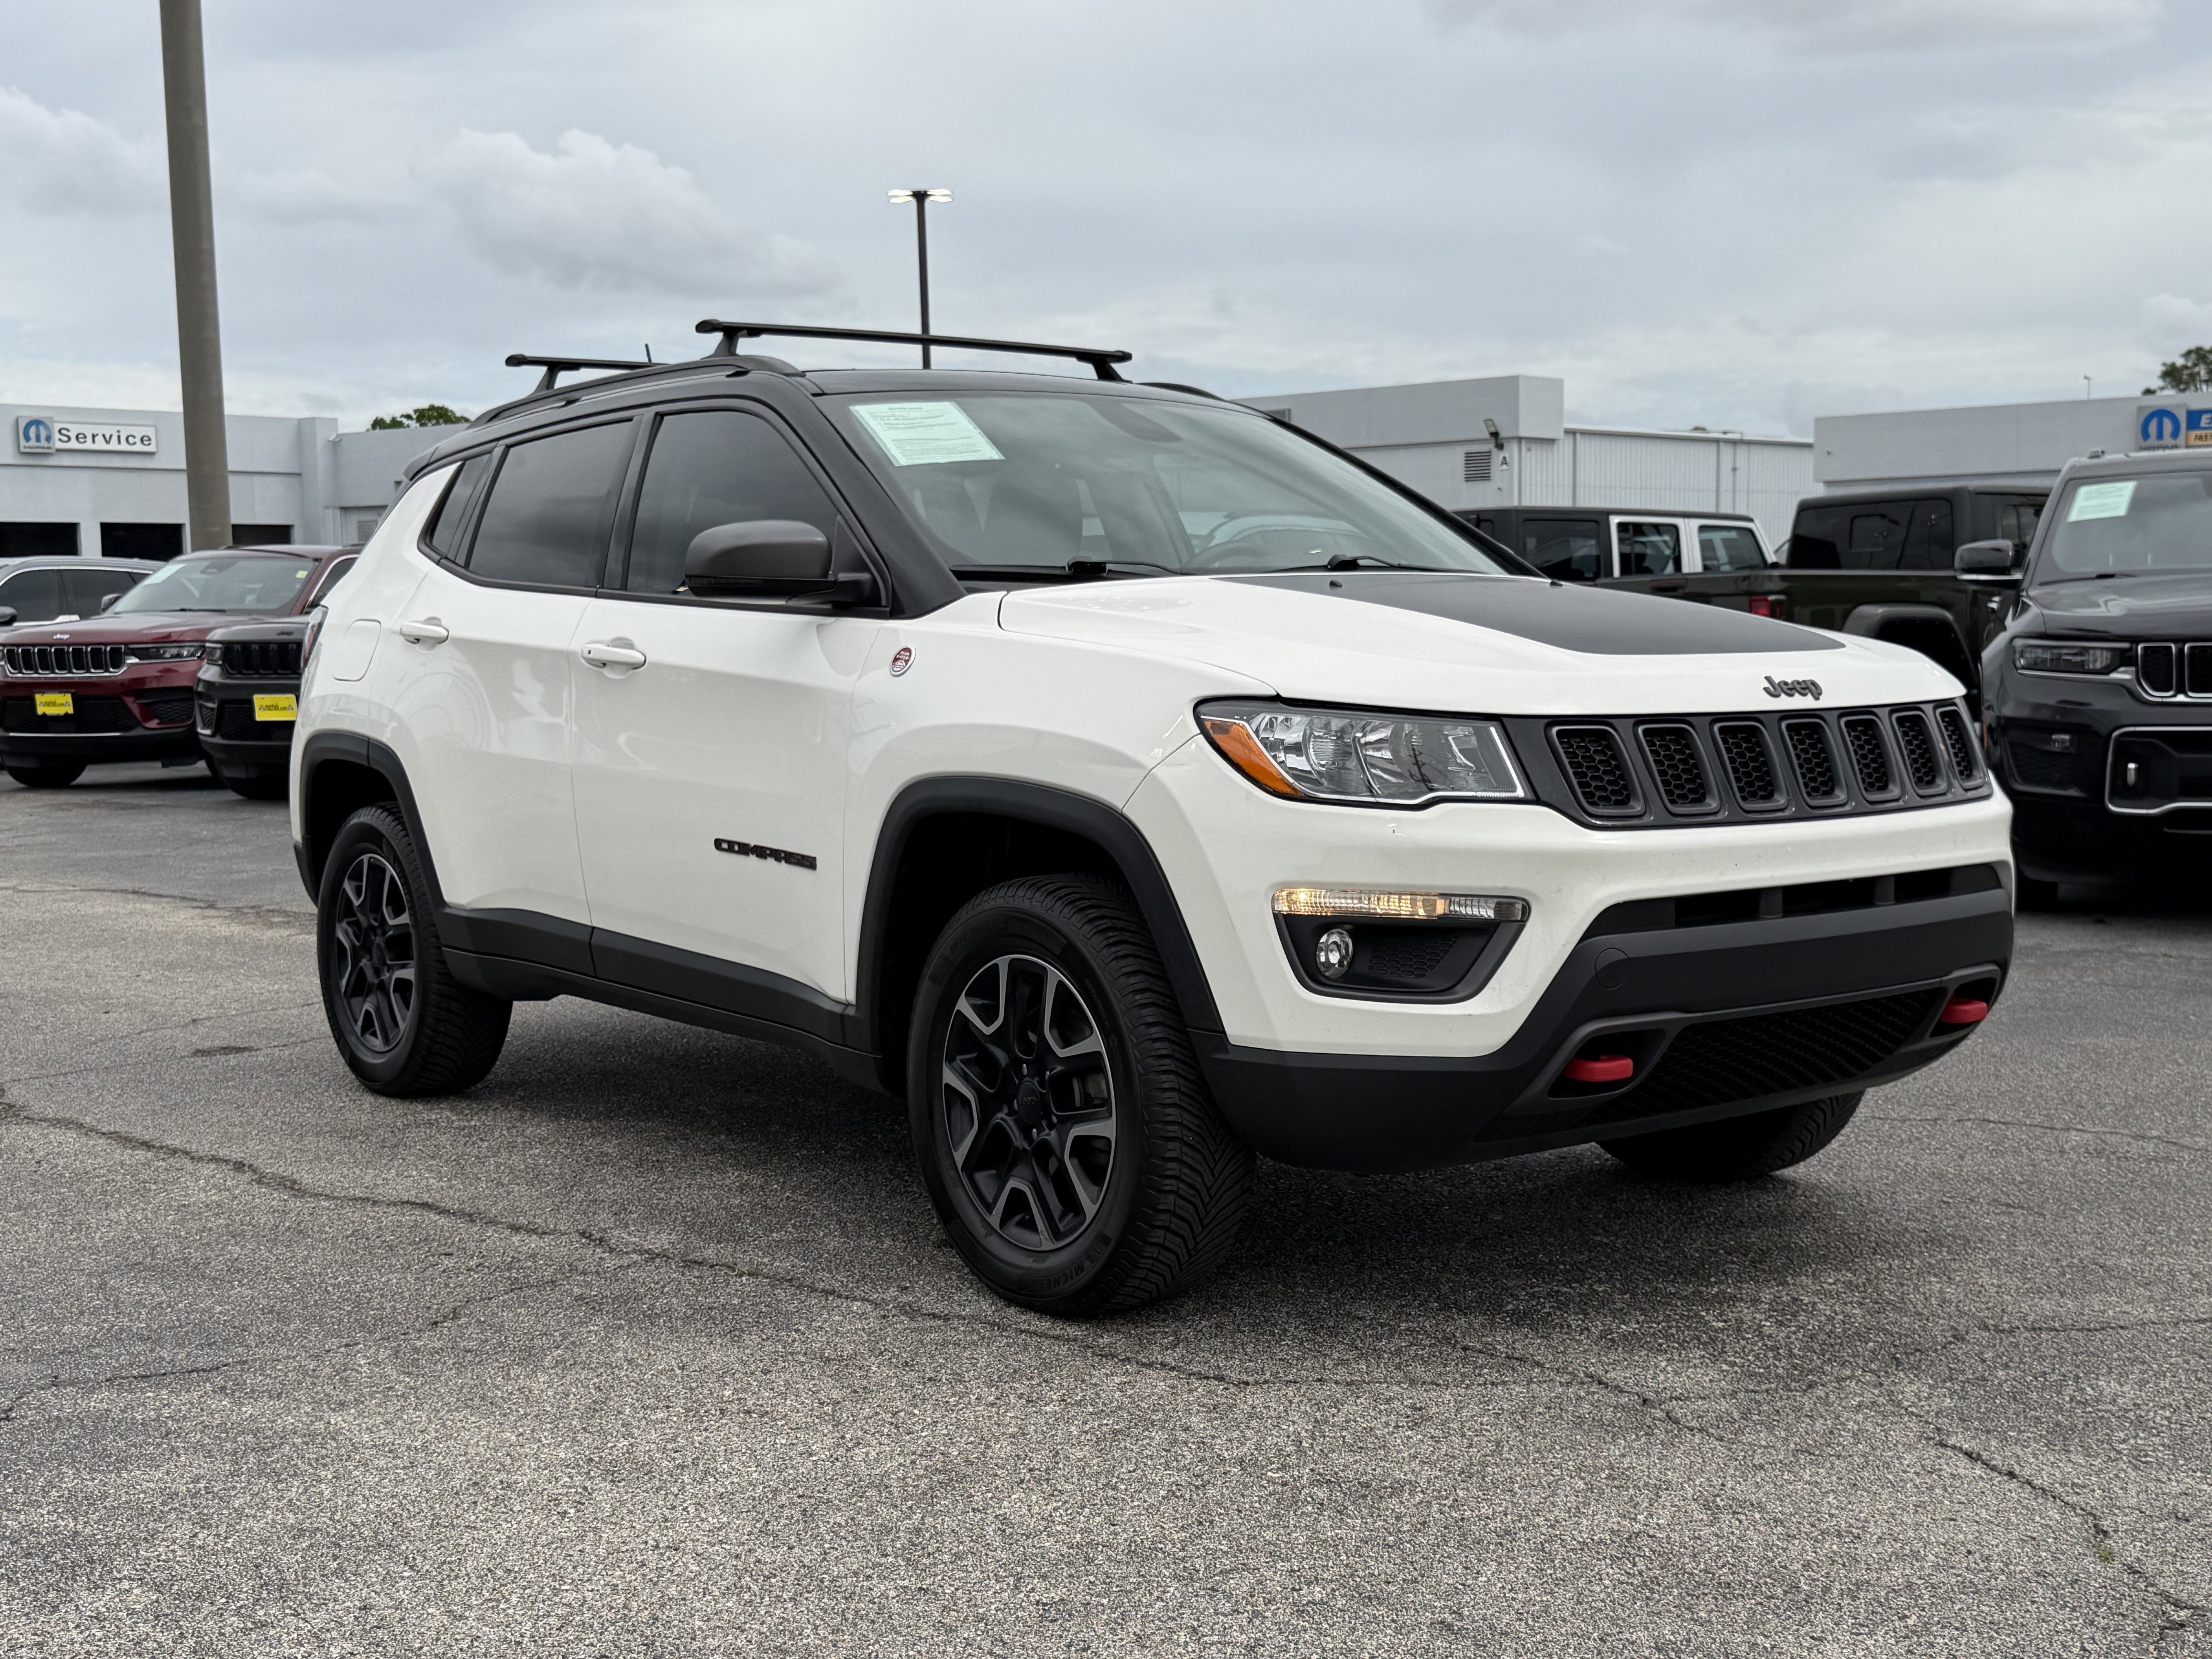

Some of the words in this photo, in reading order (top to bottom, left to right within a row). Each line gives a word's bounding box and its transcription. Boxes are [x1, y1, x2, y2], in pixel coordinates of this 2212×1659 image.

[58, 428, 152, 446] Service
[1500, 456, 1508, 467] A
[1763, 676, 1823, 701] Jeep
[714, 838, 817, 871] COMPASS
